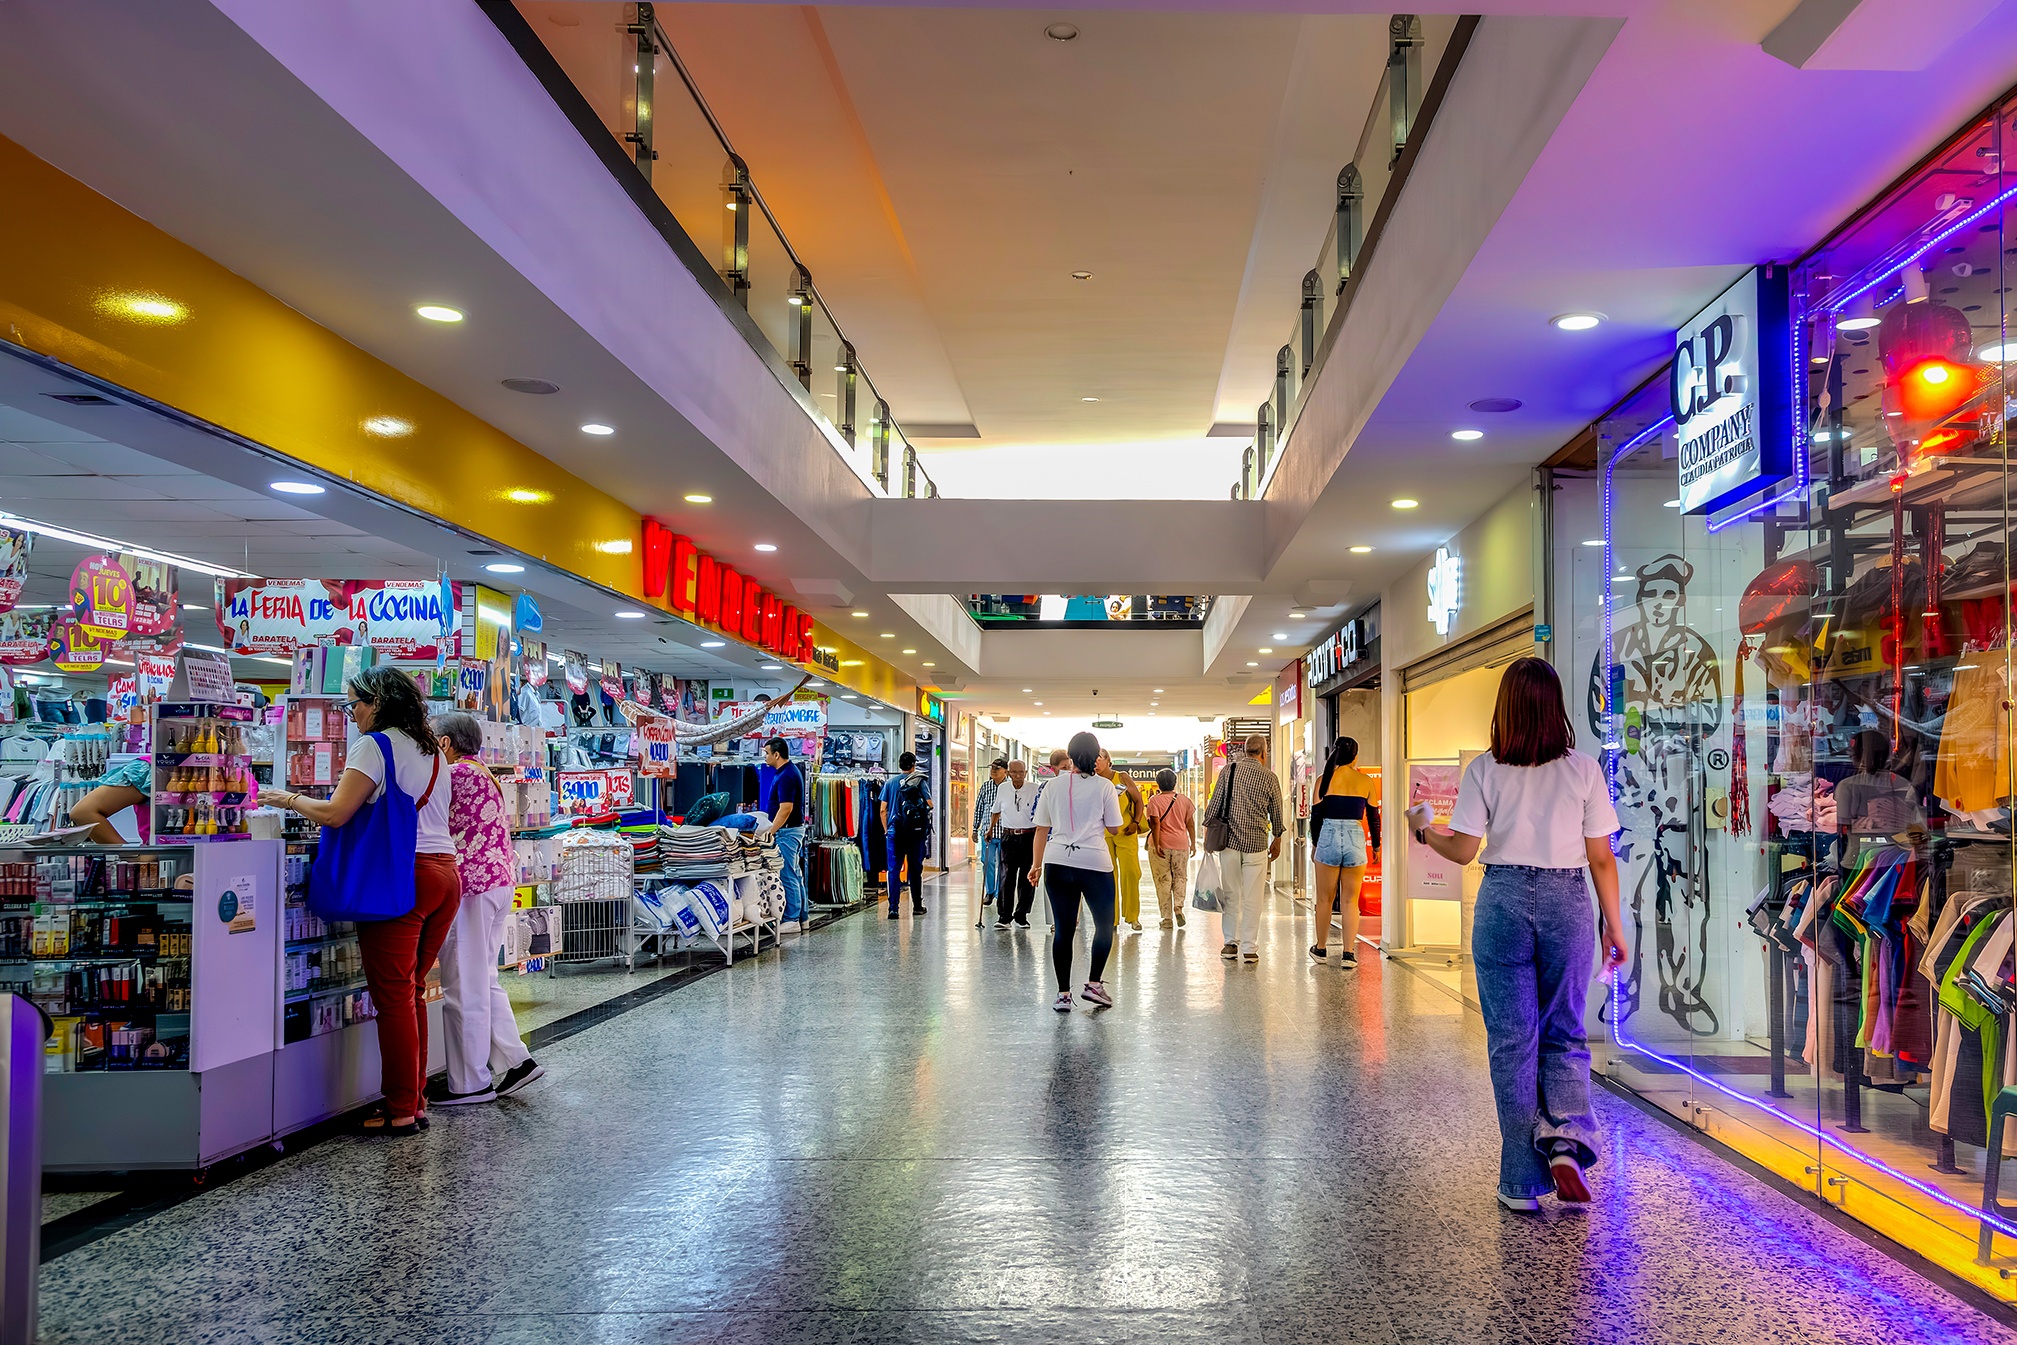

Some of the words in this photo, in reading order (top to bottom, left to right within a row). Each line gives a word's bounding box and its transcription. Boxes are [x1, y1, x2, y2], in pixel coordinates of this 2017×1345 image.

[1681, 403, 1754, 470] COMPANY
[1681, 458, 1713, 487] CLAUDIA
[1714, 437, 1755, 469] PATRICIA
[99, 568, 120, 578] JUEVES
[641, 518, 814, 665] VENDEMAS
[231, 597, 249, 619] LA
[250, 590, 306, 628] FERIA
[309, 598, 334, 621] DE
[348, 596, 368, 622] LA
[369, 590, 446, 628] COCINA
[98, 616, 123, 627] TELAS
[88, 627, 118, 636] VENDEMAS
[252, 635, 298, 643] BARATELA
[73, 654, 98, 662] TELAS
